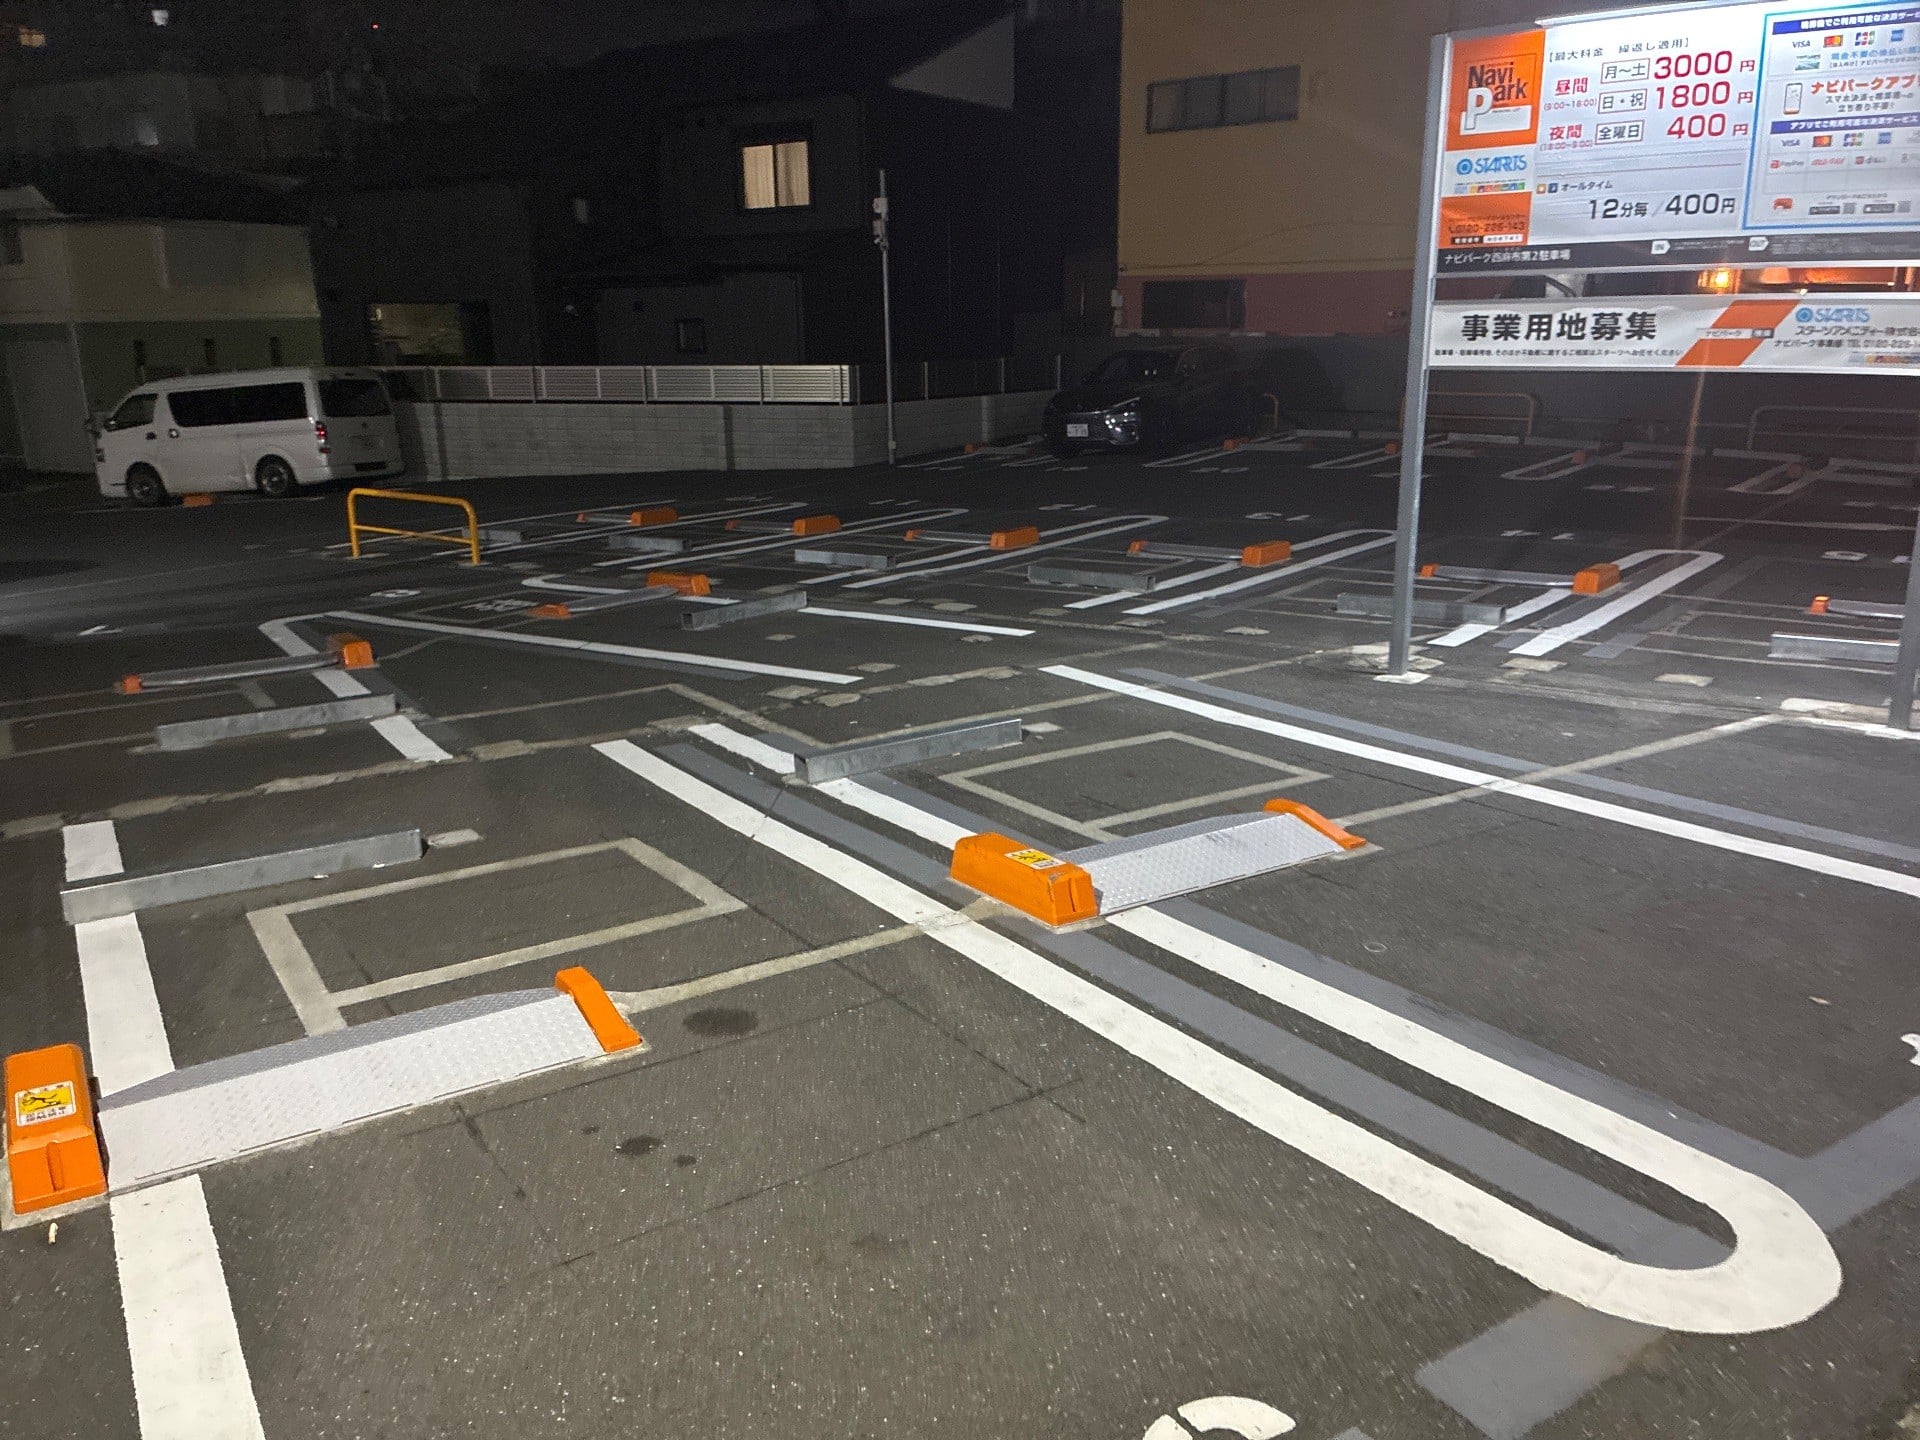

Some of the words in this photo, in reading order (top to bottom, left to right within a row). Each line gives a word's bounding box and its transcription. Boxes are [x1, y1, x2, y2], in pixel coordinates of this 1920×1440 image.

[1468, 61, 1514, 89] Navi
[1811, 74, 1920, 94] ナビパークアプ
[1555, 77, 1588, 96] 昼間
[1464, 78, 1528, 130] Park
[1549, 124, 1583, 140] 夜間
[1599, 125, 1640, 141] 全曜日
[1474, 155, 1528, 174] STARTS
[1561, 181, 1613, 191] オールタイム
[1814, 308, 1871, 323] STARTS
[1462, 311, 1657, 342] 事業用地募集
